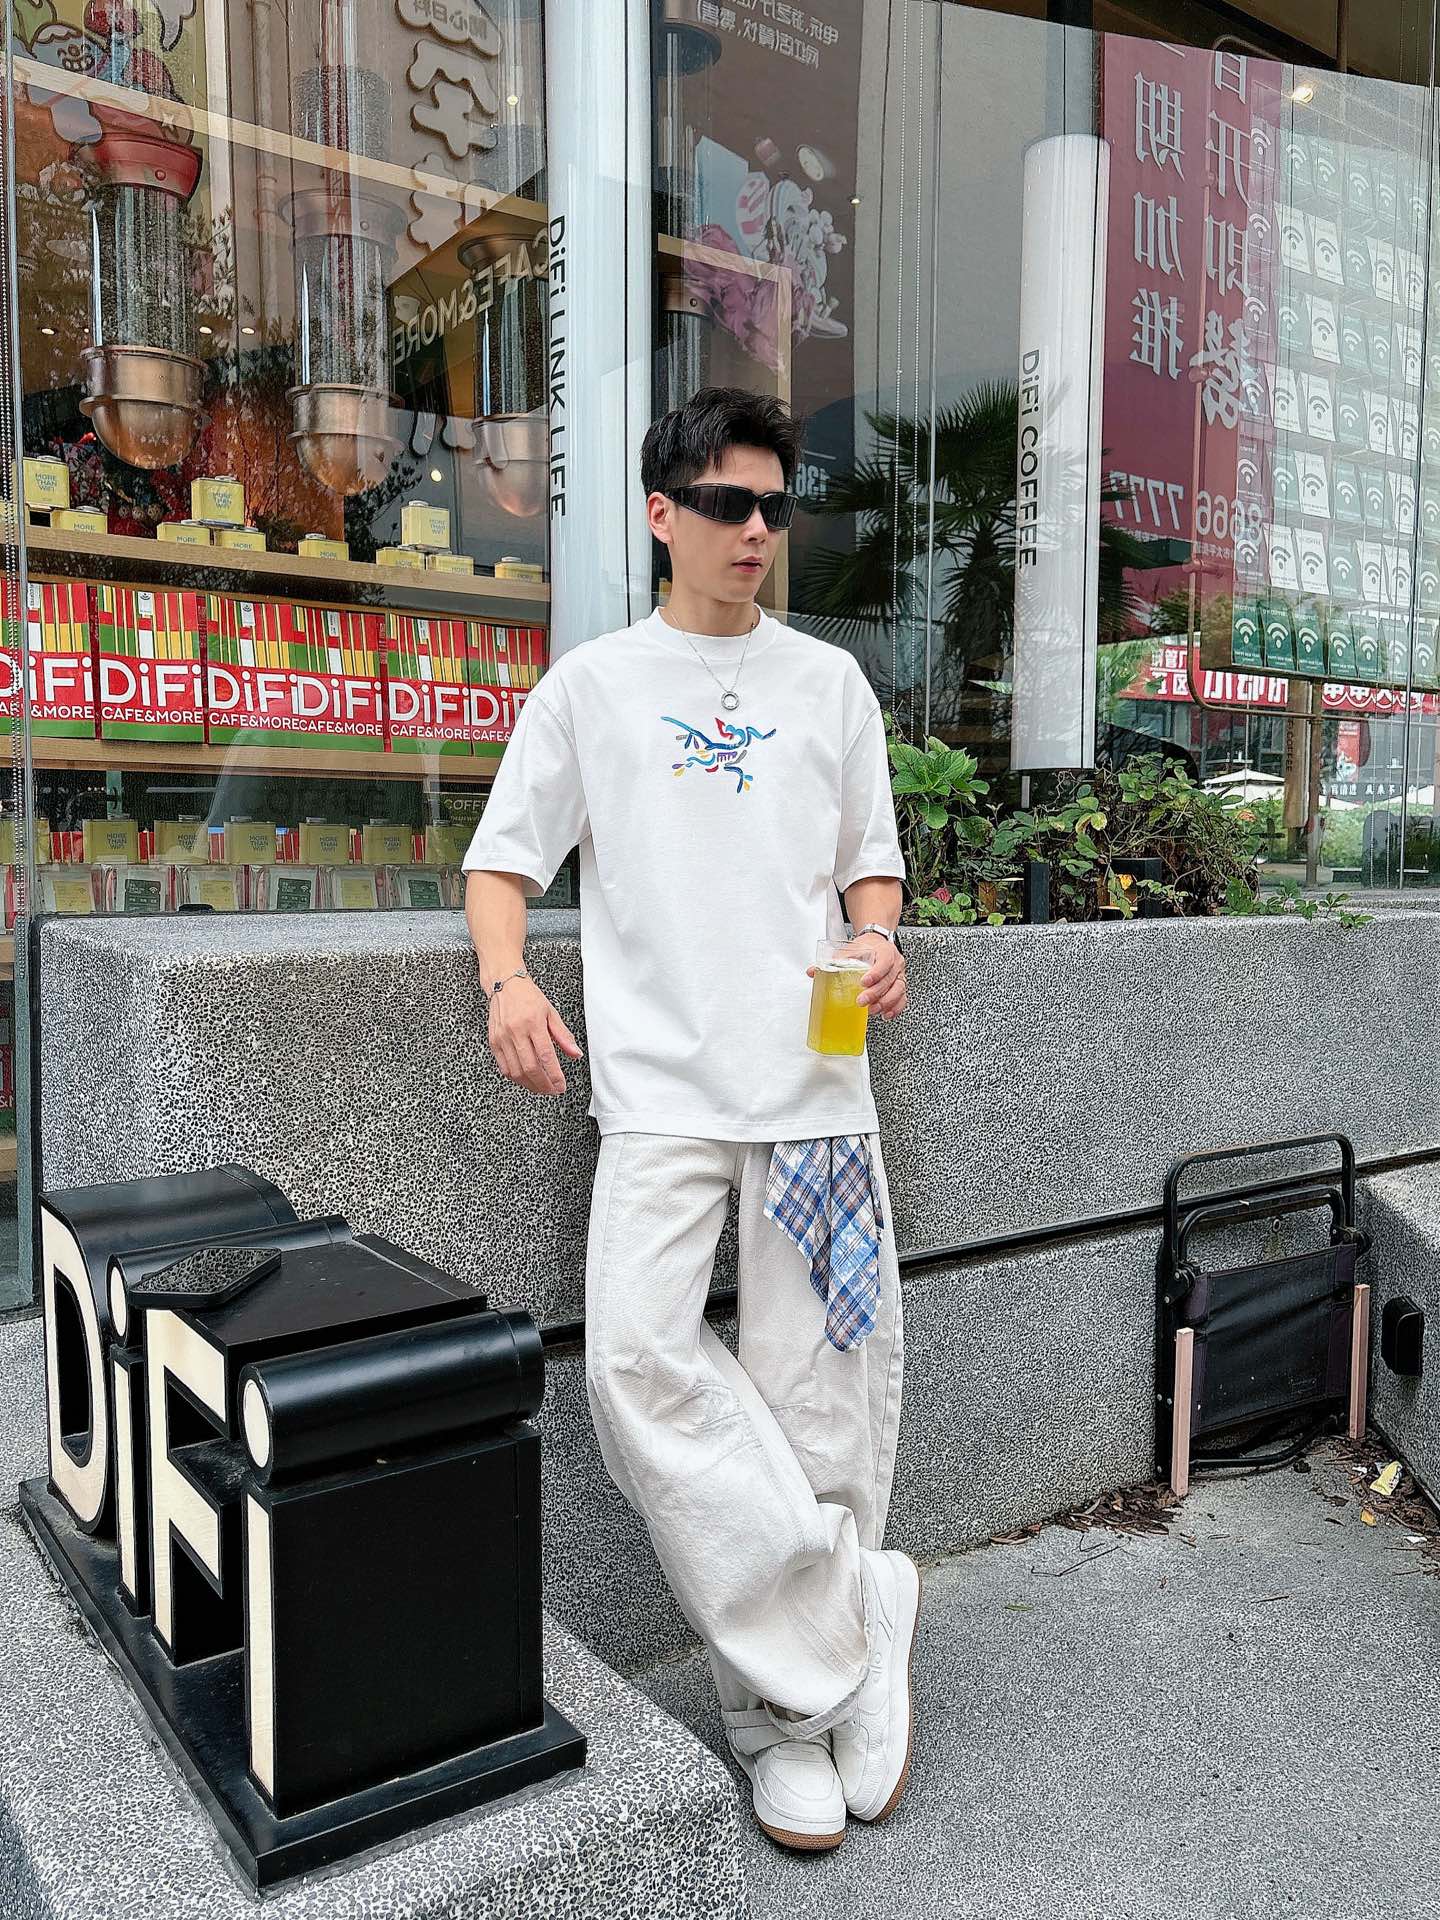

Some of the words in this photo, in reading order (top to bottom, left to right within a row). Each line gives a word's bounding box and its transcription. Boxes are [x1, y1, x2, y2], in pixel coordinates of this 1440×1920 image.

[550, 215, 566, 297] DiFi
[550, 308, 566, 413] LINK
[1021, 349, 1040, 416] DiFi
[550, 425, 566, 521] LIFE
[1018, 425, 1039, 570] COFFEE
[73, 522, 96, 531] MORE
[176, 535, 198, 543] MORE
[100, 658, 203, 708] DiFi
[208, 665, 298, 716] DiFi
[298, 675, 383, 721] DiFi
[389, 681, 471, 726] DiFi
[102, 706, 203, 724] CAFE&MORE
[209, 711, 300, 731] CAFE&MORE
[299, 719, 384, 737] CAFE&MORE
[470, 687, 528, 728] DiF
[390, 723, 471, 741] CAFE&MORE
[472, 728, 511, 742] CAFE&
[41, 1197, 276, 1800] DiFi
